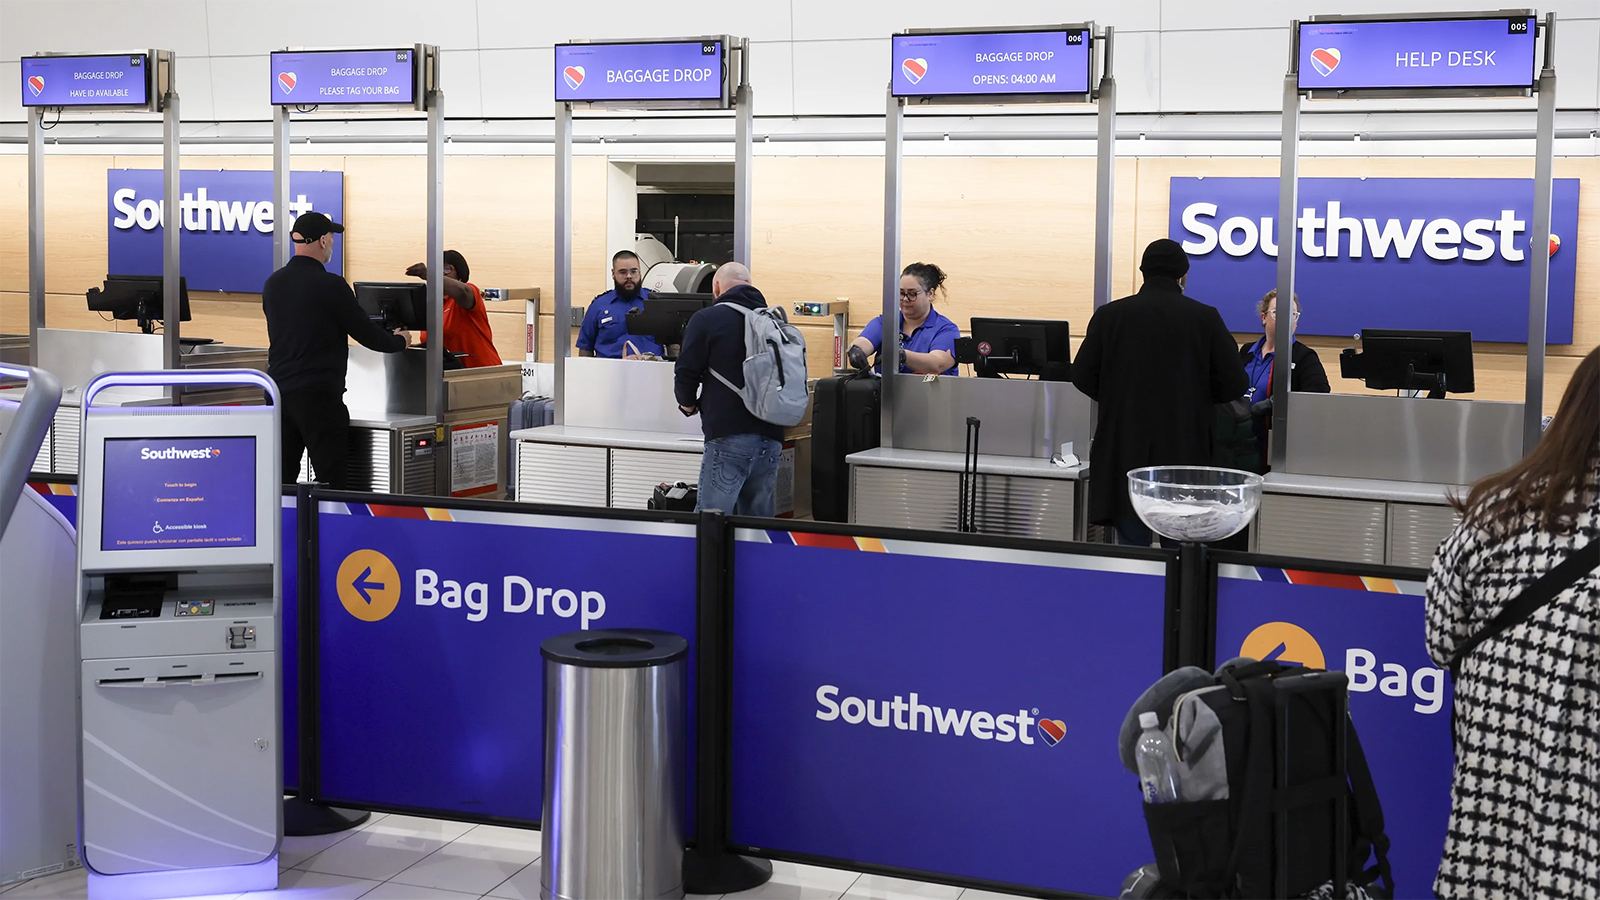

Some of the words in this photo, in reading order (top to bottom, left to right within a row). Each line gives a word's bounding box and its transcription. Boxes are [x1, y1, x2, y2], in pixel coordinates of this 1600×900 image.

[1510, 23, 1527, 31] 005
[975, 52, 1023, 62] BAGGAGE
[1025, 51, 1054, 61] DROP
[1395, 51, 1442, 67] HELP
[1447, 50, 1496, 66] DESK
[74, 72, 104, 80] BAGGAGE
[105, 71, 123, 79] DROP
[331, 68, 365, 77] BAGGAGE
[367, 67, 388, 76] DROP
[607, 69, 670, 83] BAGGAGE
[673, 68, 712, 82] DROP
[972, 74, 1009, 85] OPENS:
[1011, 74, 1038, 84] 04:00
[1039, 73, 1056, 83] AM
[70, 89, 87, 97] HAVE
[87, 89, 95, 97] ID
[95, 89, 129, 97] AVAILABLE
[320, 87, 344, 95] PLEASE
[346, 87, 361, 95] TAG
[361, 86, 382, 95] YOUR
[384, 86, 399, 94] BAG
[113, 187, 313, 234] Sothwet
[521, 368, 535, 377] 2-01
[415, 568, 488, 622] Bag
[503, 575, 606, 631] Drop
[1346, 648, 1445, 714] Bag
